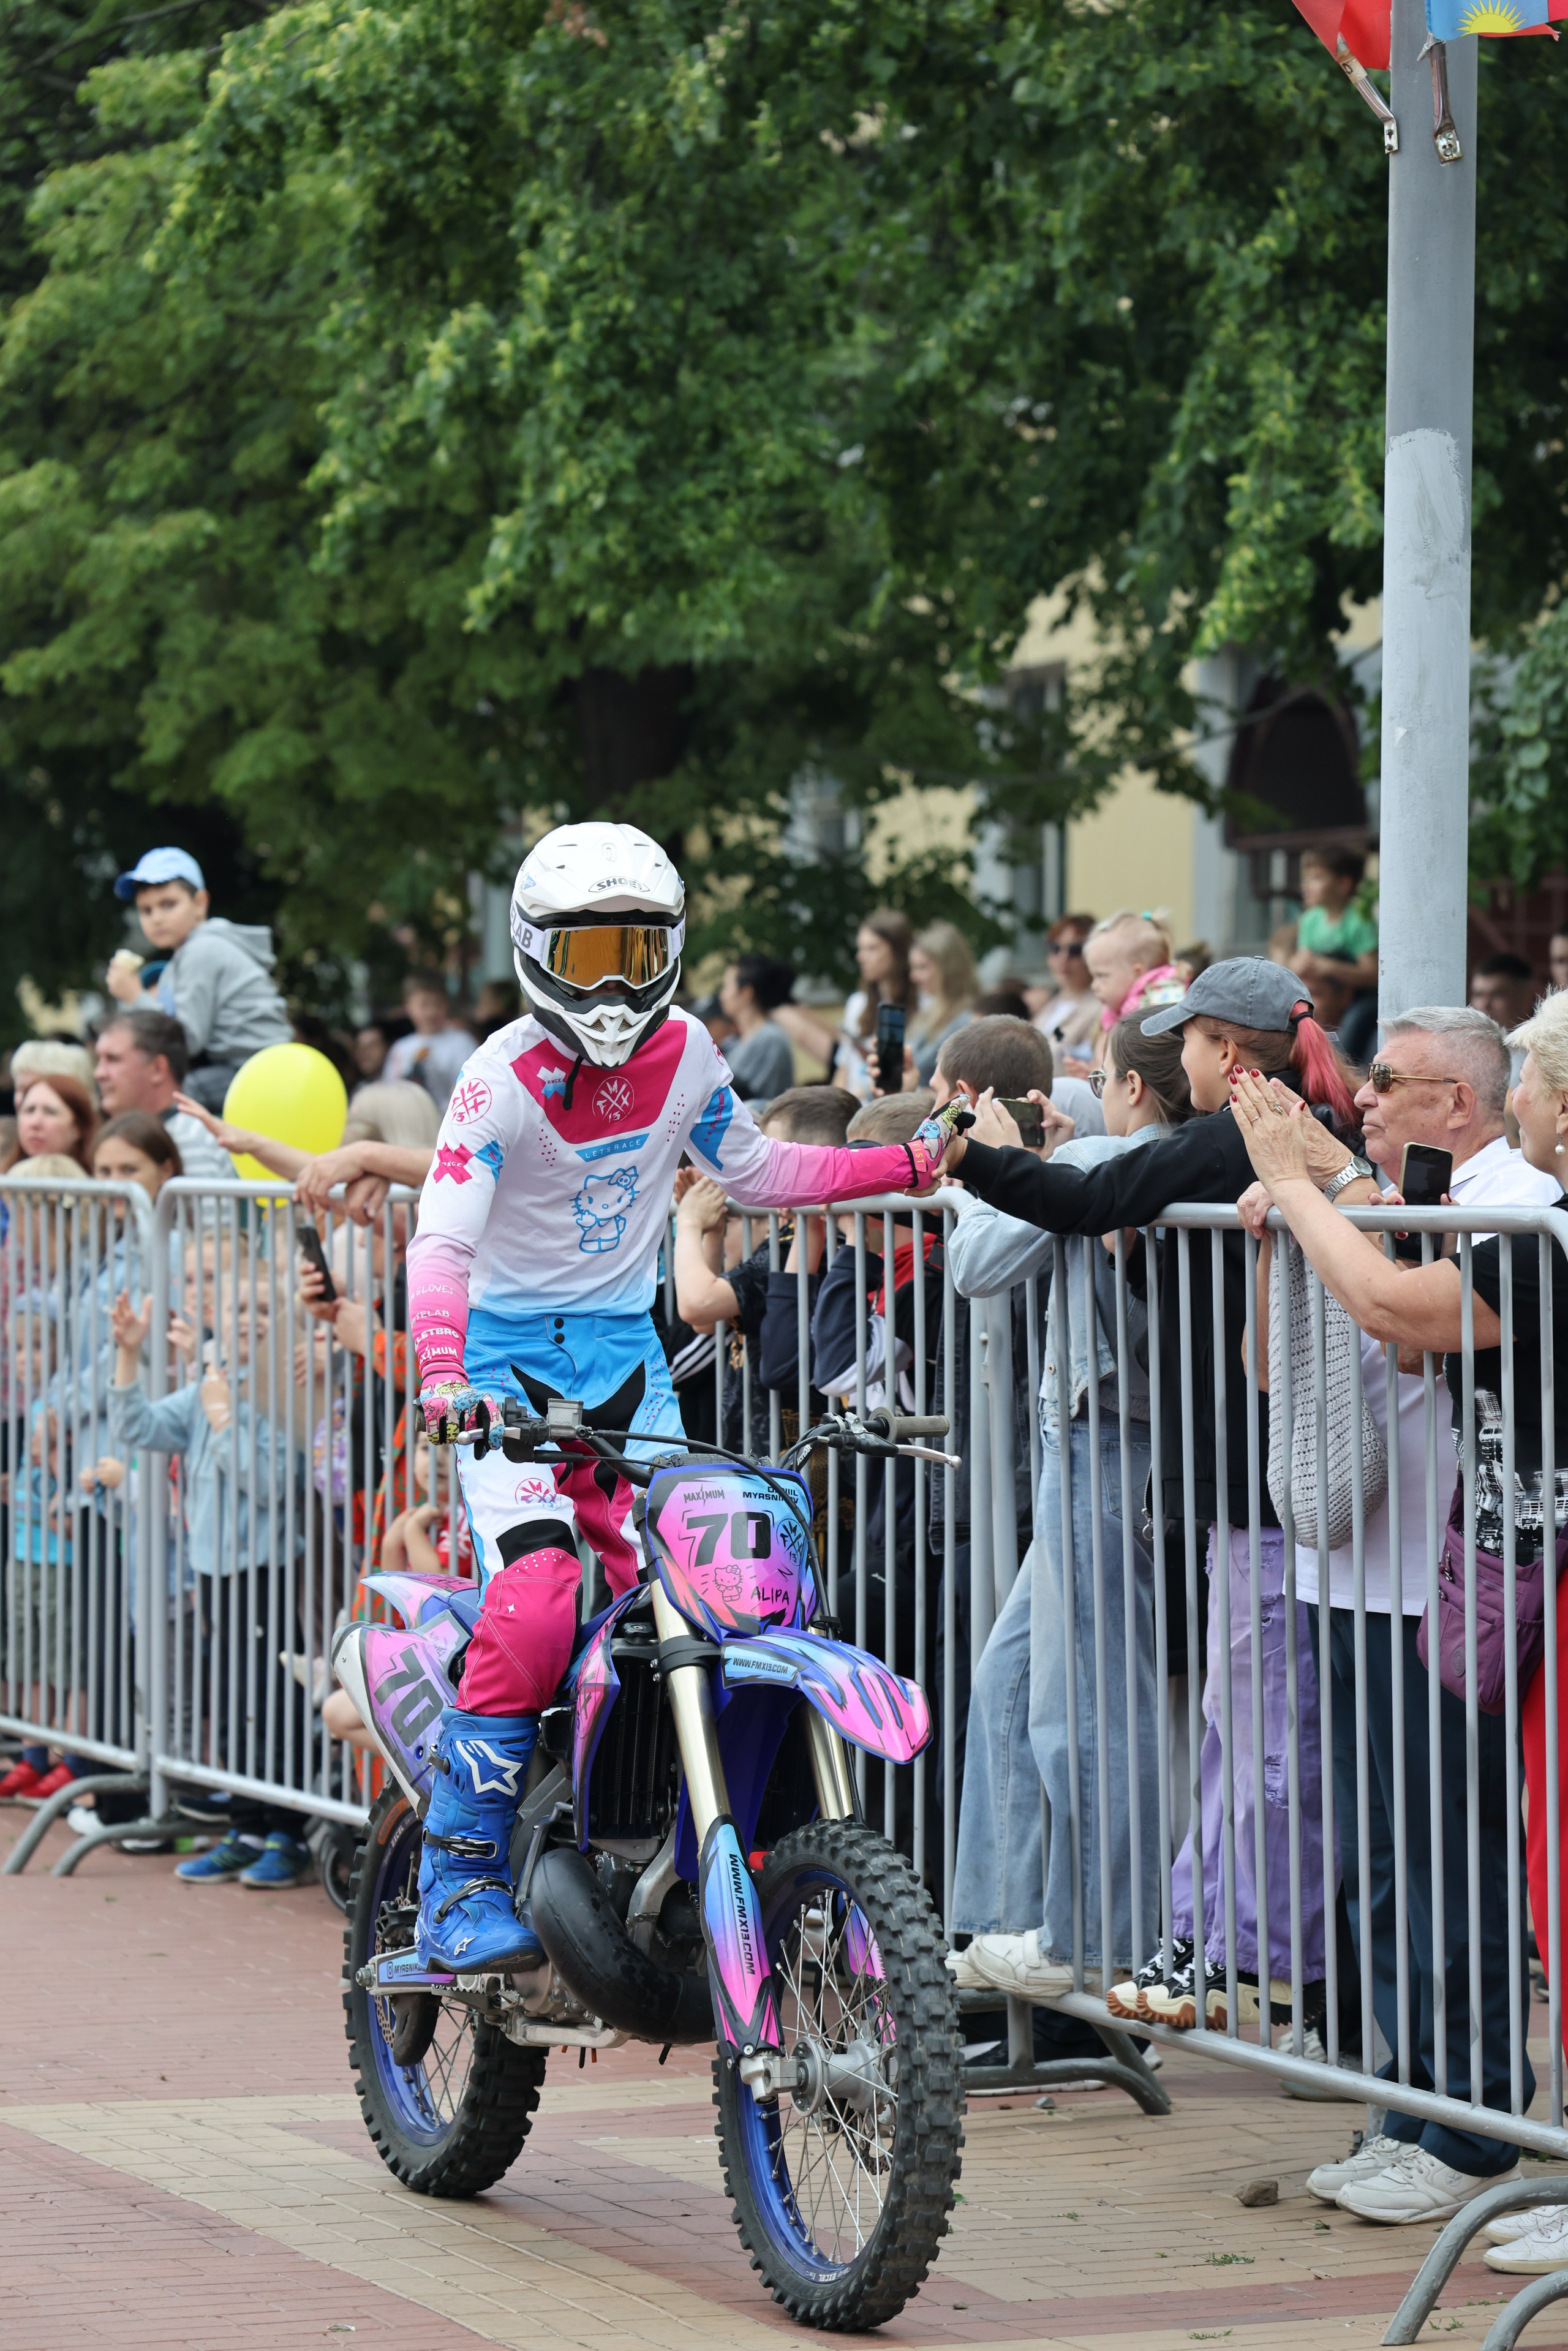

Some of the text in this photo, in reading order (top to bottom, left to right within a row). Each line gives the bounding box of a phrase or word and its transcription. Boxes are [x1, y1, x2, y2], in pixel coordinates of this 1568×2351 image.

[596, 877, 643, 891] SHOEI
[510, 904, 533, 949] ELAB
[585, 1139, 641, 1159] LET'S RACE
[912, 1143, 924, 1164] FIST
[416, 1284, 453, 1296] GLOVES
[411, 1310, 450, 1327] HITELAB
[684, 1487, 725, 1505] MAXIMUM
[687, 1511, 771, 1567] 70
[751, 1585, 790, 1604] ALIPA
[733, 1657, 789, 1675] WWW.FMX13.COM
[374, 1646, 444, 1748] 70
[391, 1825, 404, 1847] EXCEL
[728, 1853, 755, 1976] WWW.FMX13.COM
[818, 2273, 837, 2282] EXCEL
